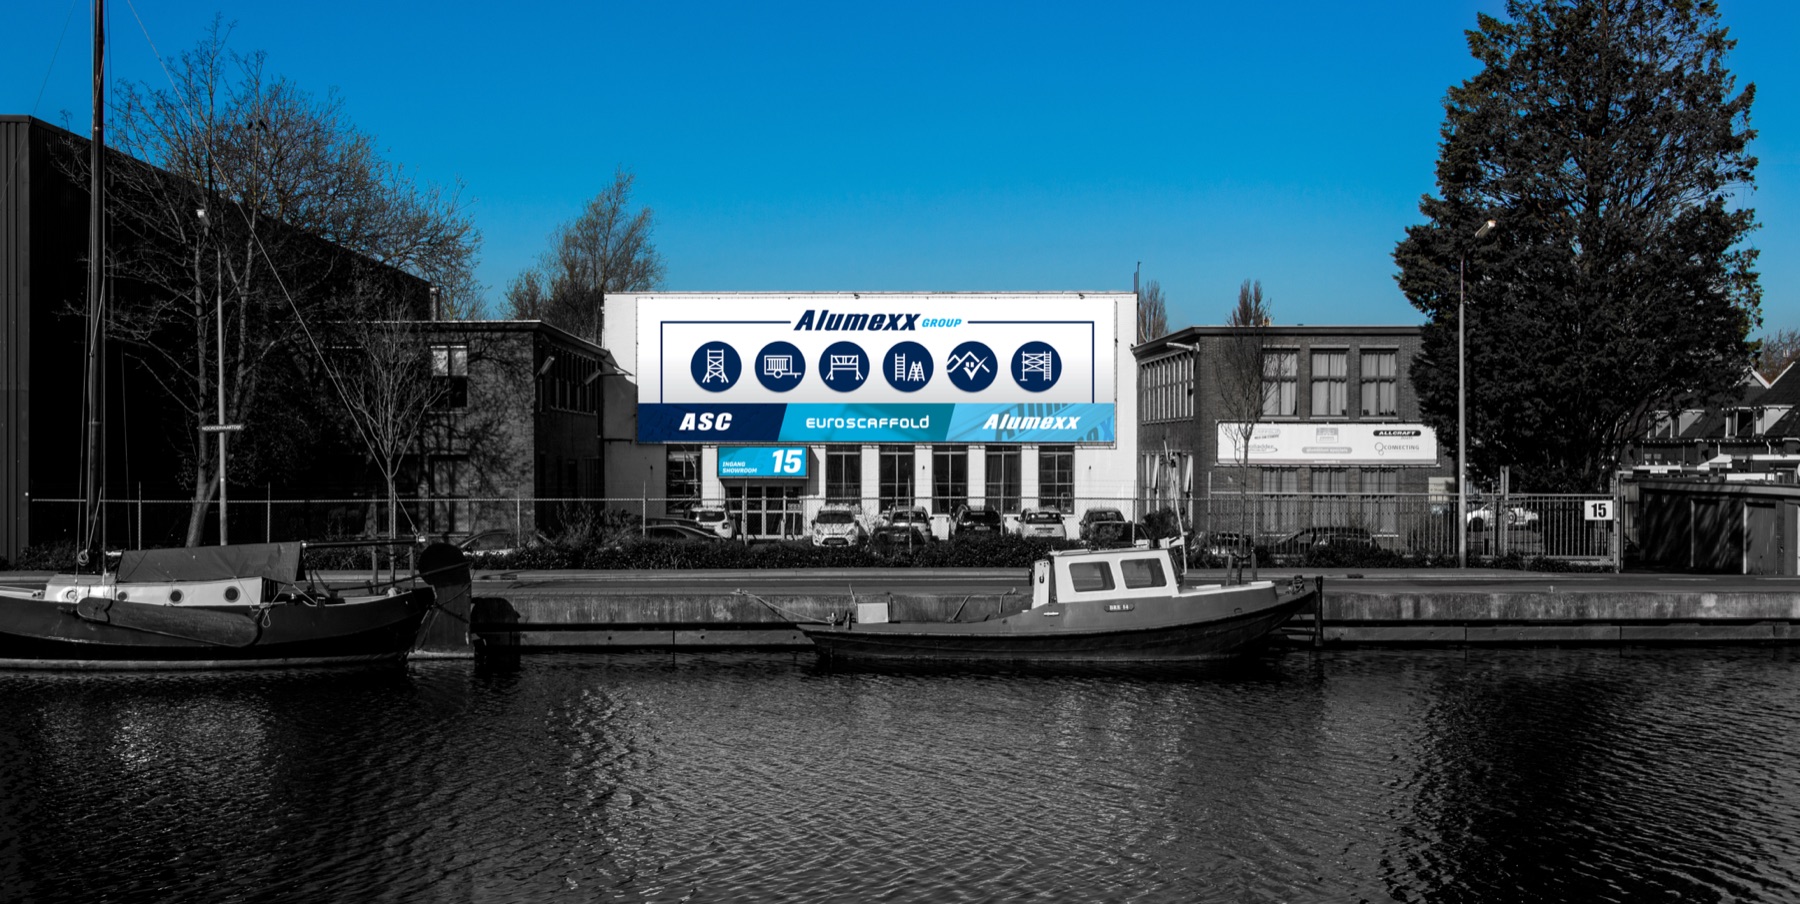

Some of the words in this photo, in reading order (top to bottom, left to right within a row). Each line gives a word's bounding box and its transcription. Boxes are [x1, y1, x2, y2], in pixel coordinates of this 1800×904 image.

[793, 309, 921, 331] Alumexx
[921, 318, 962, 328] GROUP
[679, 412, 733, 431] ASC
[982, 413, 1082, 430] Alumexx
[772, 449, 803, 474] 15
[1591, 503, 1607, 518] 15
